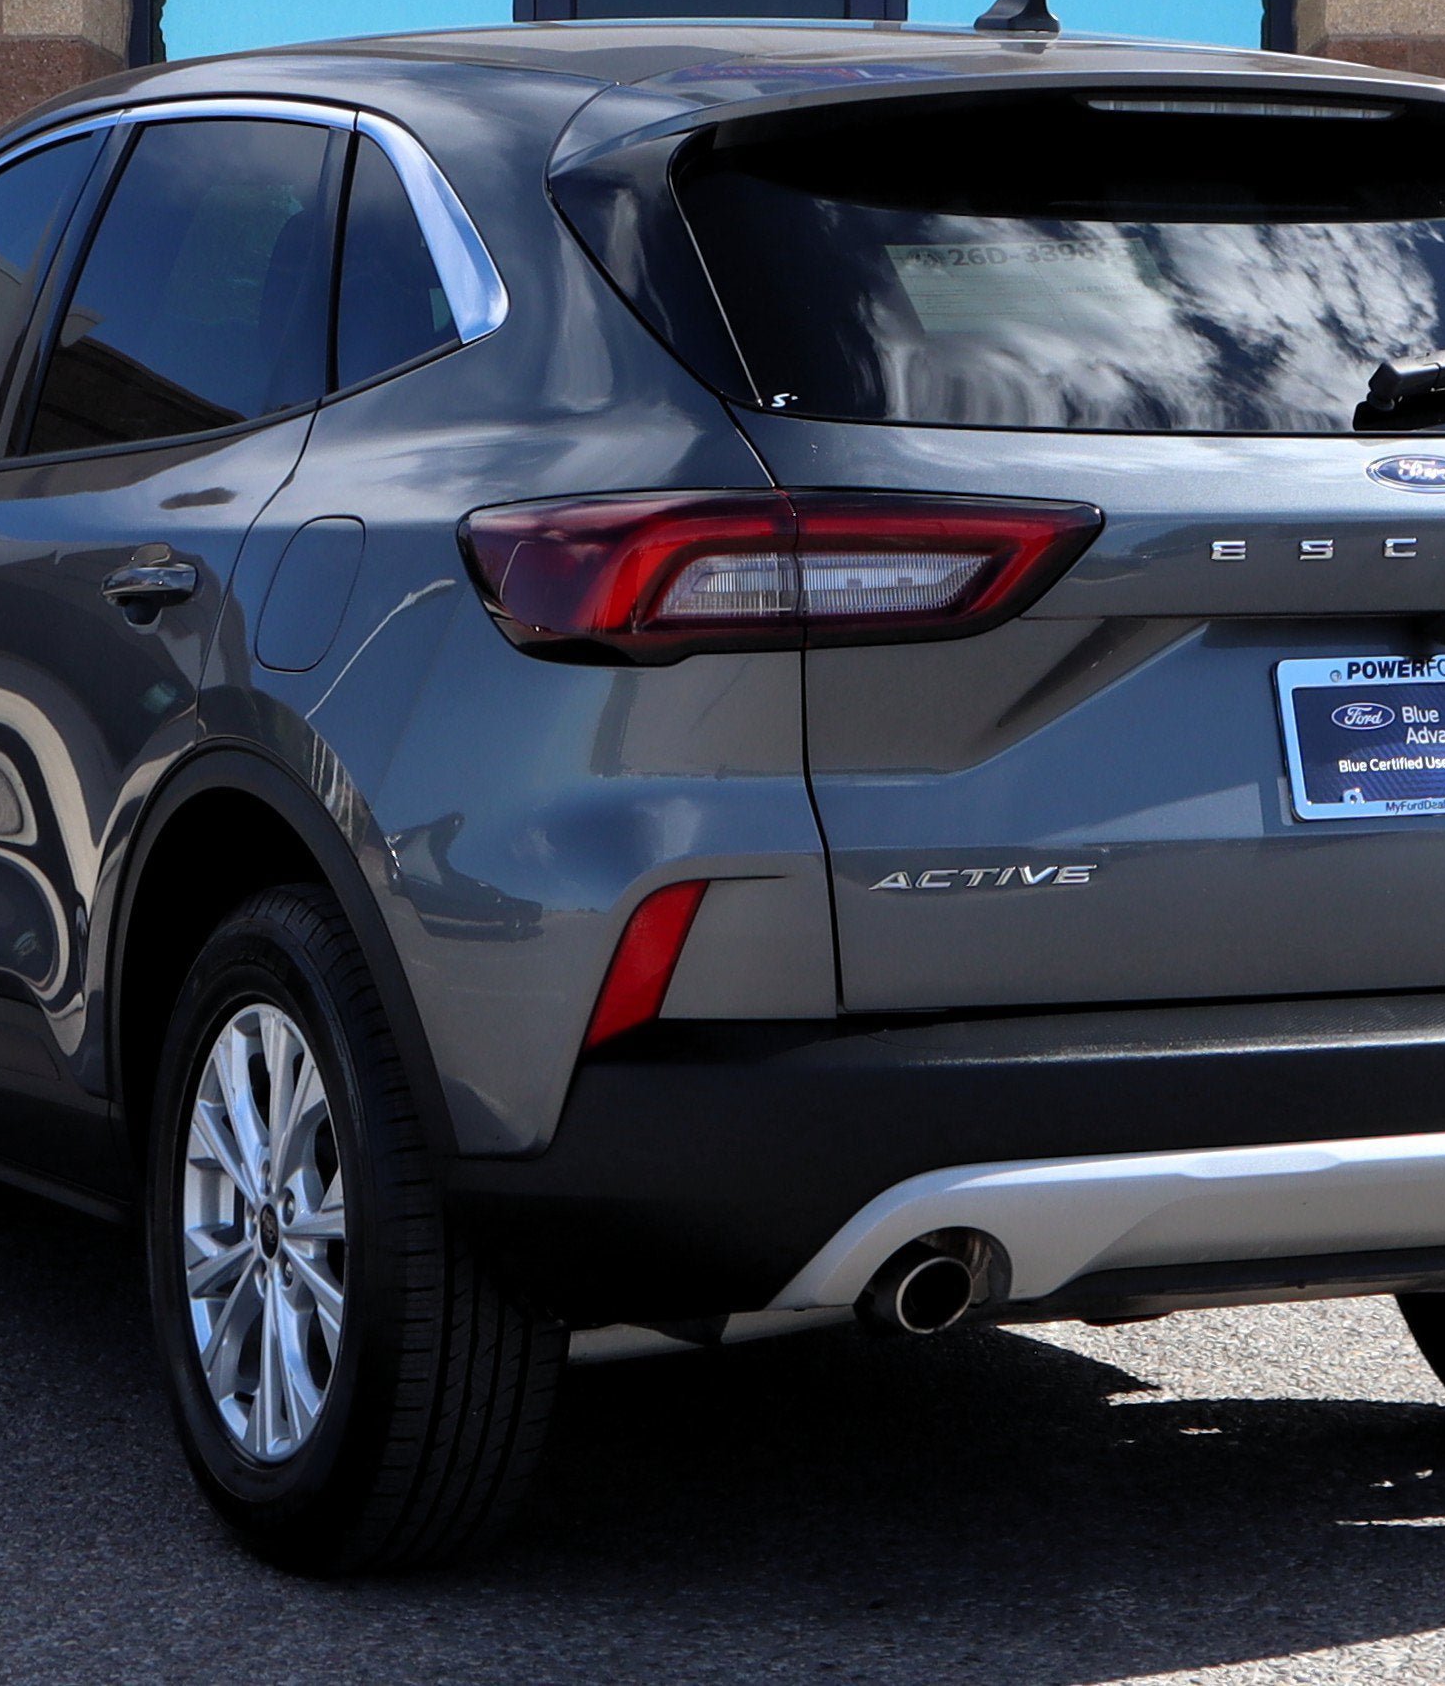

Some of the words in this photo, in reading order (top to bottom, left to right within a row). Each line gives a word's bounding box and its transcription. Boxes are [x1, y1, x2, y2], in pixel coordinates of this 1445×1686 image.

[1344, 706, 1383, 725] Ford
[1402, 706, 1440, 723] Blue
[1339, 760, 1368, 773] Blue
[1369, 757, 1423, 772] Certified
[868, 864, 1098, 891] ACTIVE
